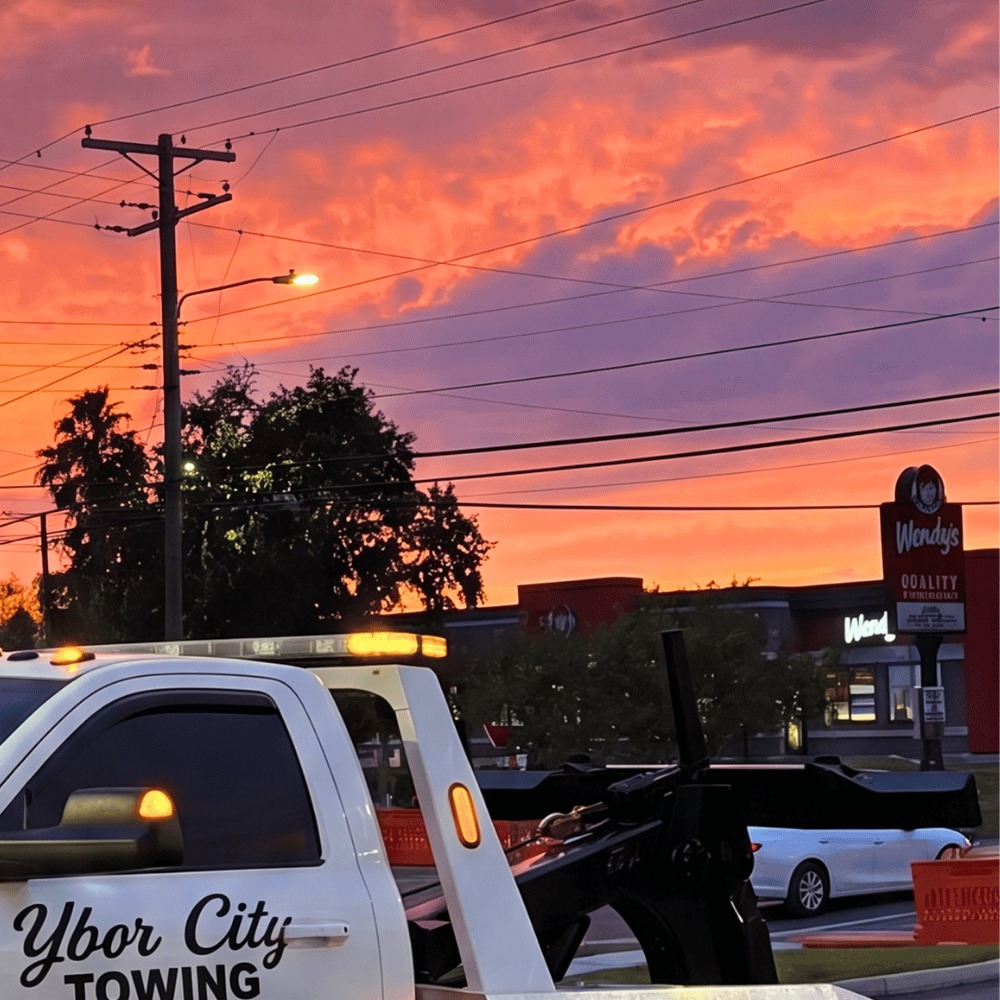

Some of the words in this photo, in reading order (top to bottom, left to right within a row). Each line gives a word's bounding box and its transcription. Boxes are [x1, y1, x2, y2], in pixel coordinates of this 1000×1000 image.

[896, 516, 960, 555] Wendy's
[13, 901, 162, 988] Ybor
[184, 893, 292, 969] City
